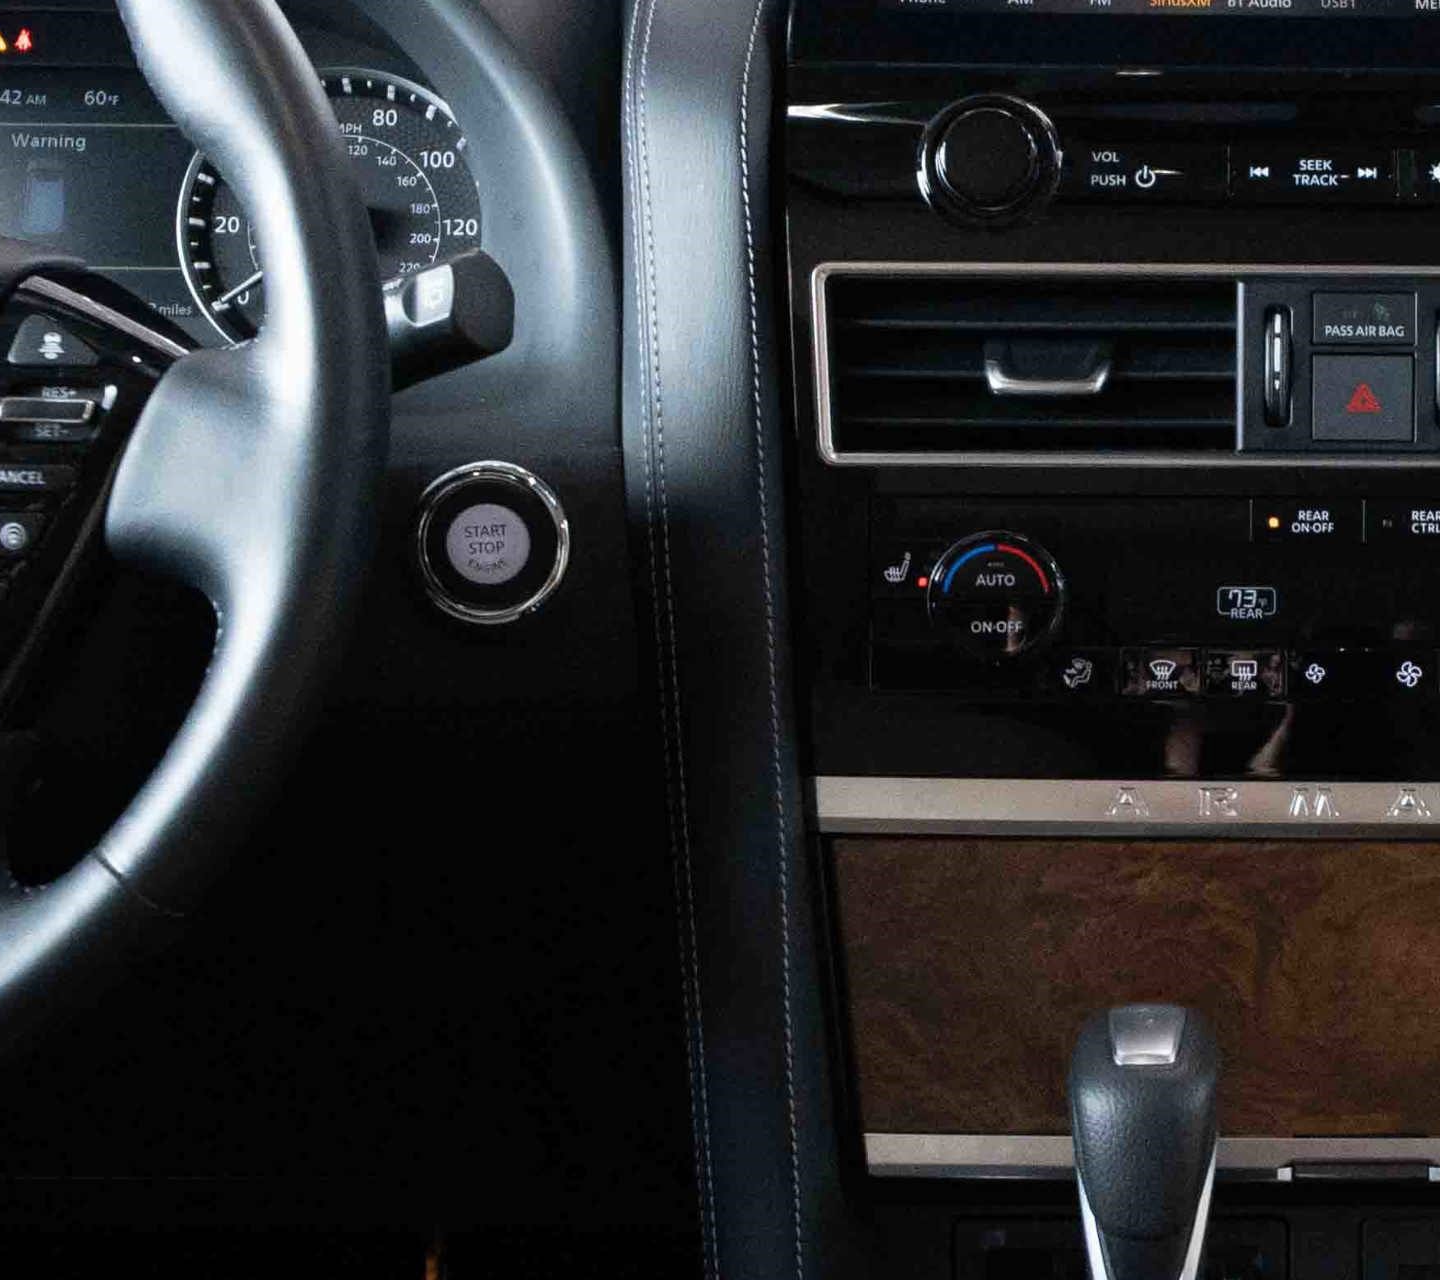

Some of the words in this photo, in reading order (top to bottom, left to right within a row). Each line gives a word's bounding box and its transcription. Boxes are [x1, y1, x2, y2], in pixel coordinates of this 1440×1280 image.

[25, 94, 47, 105] AM
[372, 108, 398, 127] 80
[11, 133, 86, 151] Warning
[347, 145, 368, 157] 120
[1092, 151, 1120, 163] VOL
[376, 155, 397, 167] 140
[420, 151, 455, 168] 100
[1298, 159, 1332, 171] SEEK
[396, 176, 417, 188] 160
[1090, 174, 1126, 187] PUSH
[1292, 173, 1338, 187] TRACK
[410, 203, 430, 215] 180
[214, 216, 240, 233] 20
[443, 219, 478, 236] 120
[409, 232, 431, 244] 200
[158, 303, 192, 317] miles
[1325, 325, 1353, 337] PASS
[1355, 325, 1376, 337] AIR
[1378, 325, 1405, 337] BAG
[1298, 510, 1329, 521] REAR
[464, 524, 507, 539] START
[468, 540, 505, 555] STOP
[975, 574, 1016, 586] AUTO
[1230, 607, 1263, 619] REAR
[1145, 680, 1179, 690] FRONT
[1231, 681, 1257, 690] REAR
